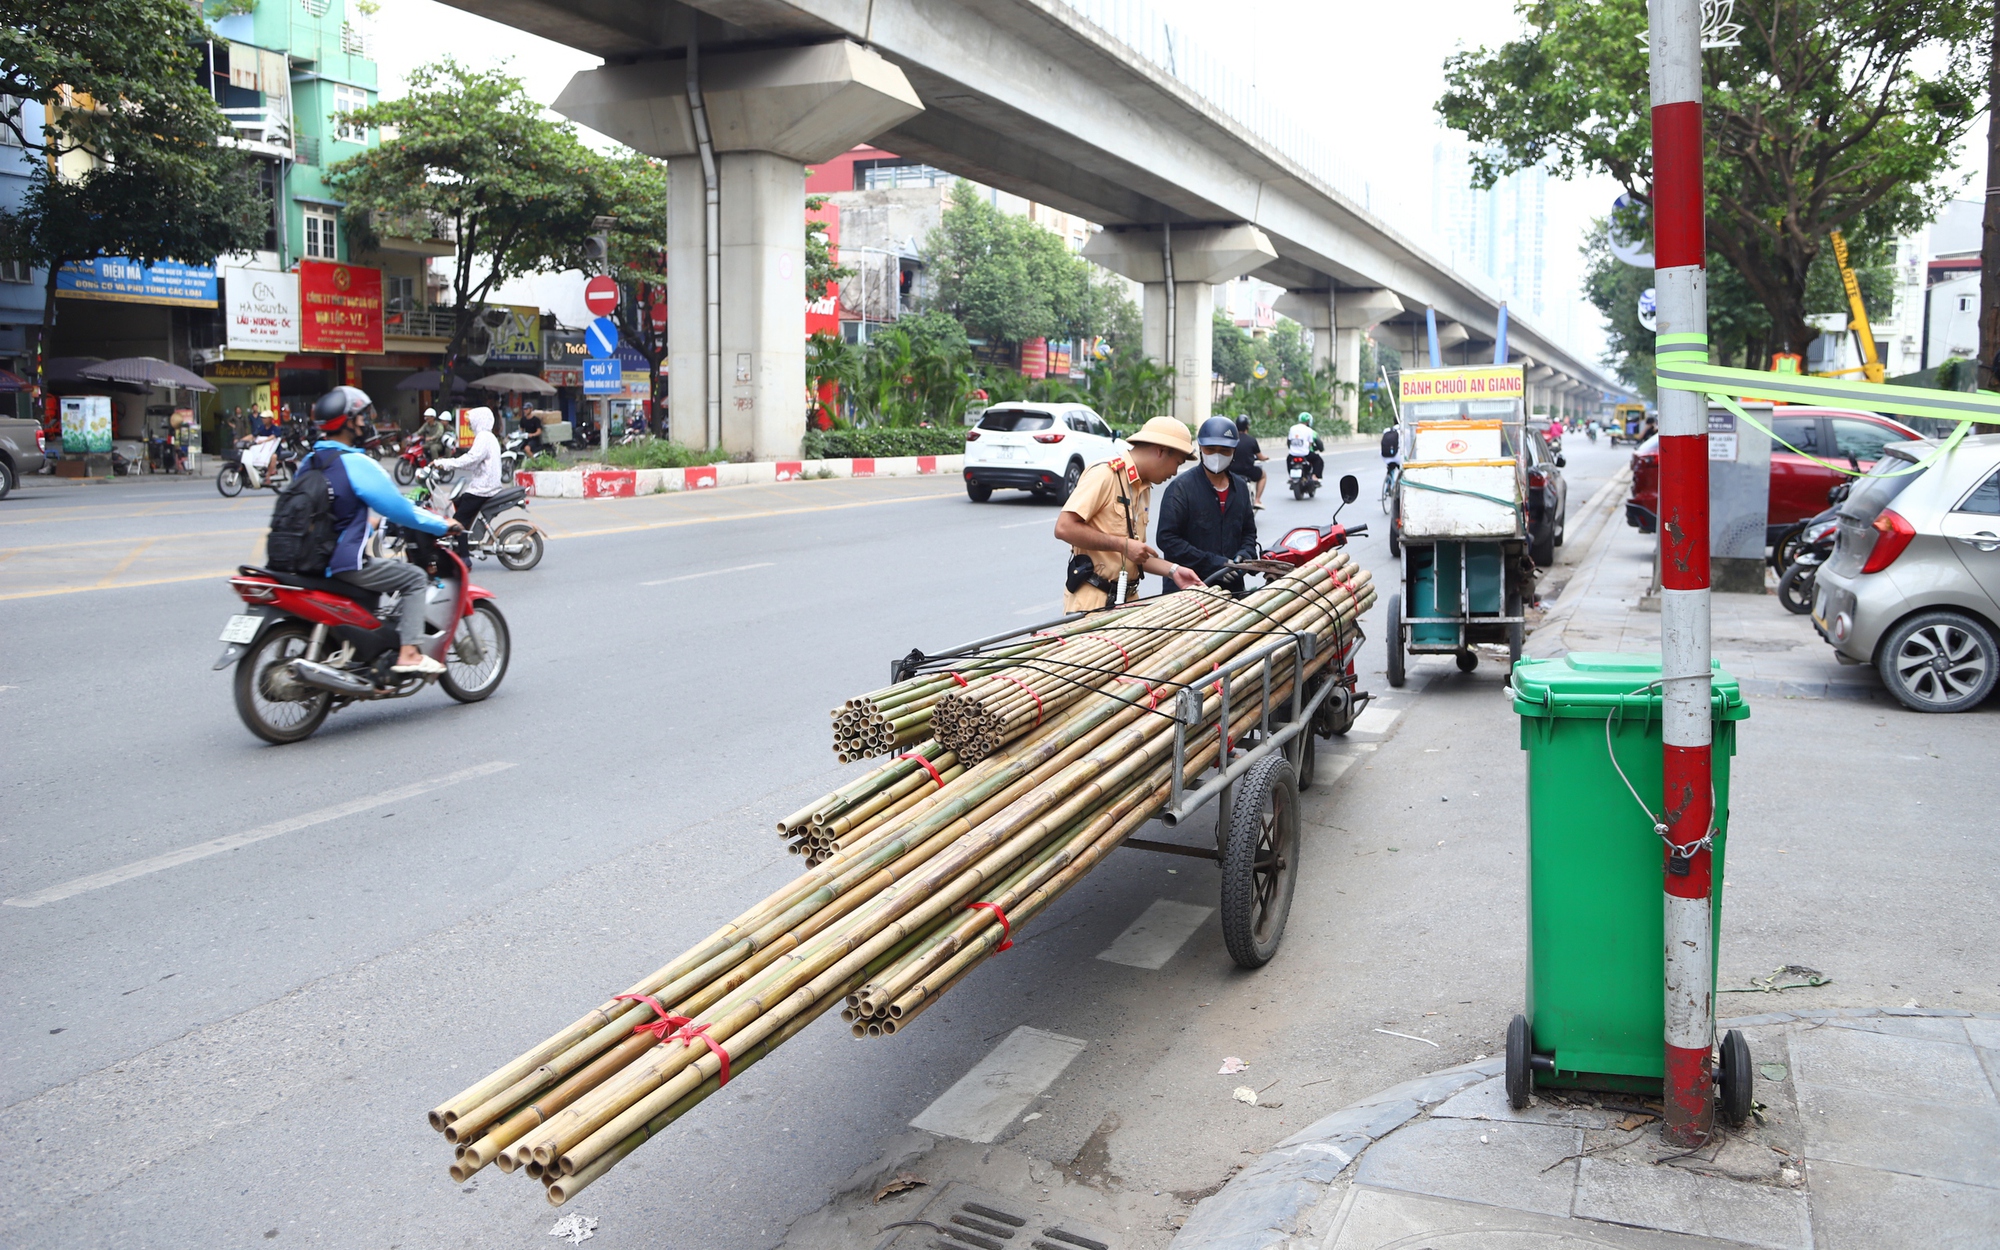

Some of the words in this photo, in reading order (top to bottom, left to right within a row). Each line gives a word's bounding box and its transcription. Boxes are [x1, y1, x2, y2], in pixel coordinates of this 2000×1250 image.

[1833, 241, 1858, 298] HAUOTTE
[590, 362, 605, 375] CHÚ
[607, 362, 613, 375] Ý
[1435, 374, 1467, 394] CHUỐI
[1470, 378, 1485, 393] AN
[1488, 377, 1521, 391] GIANG
